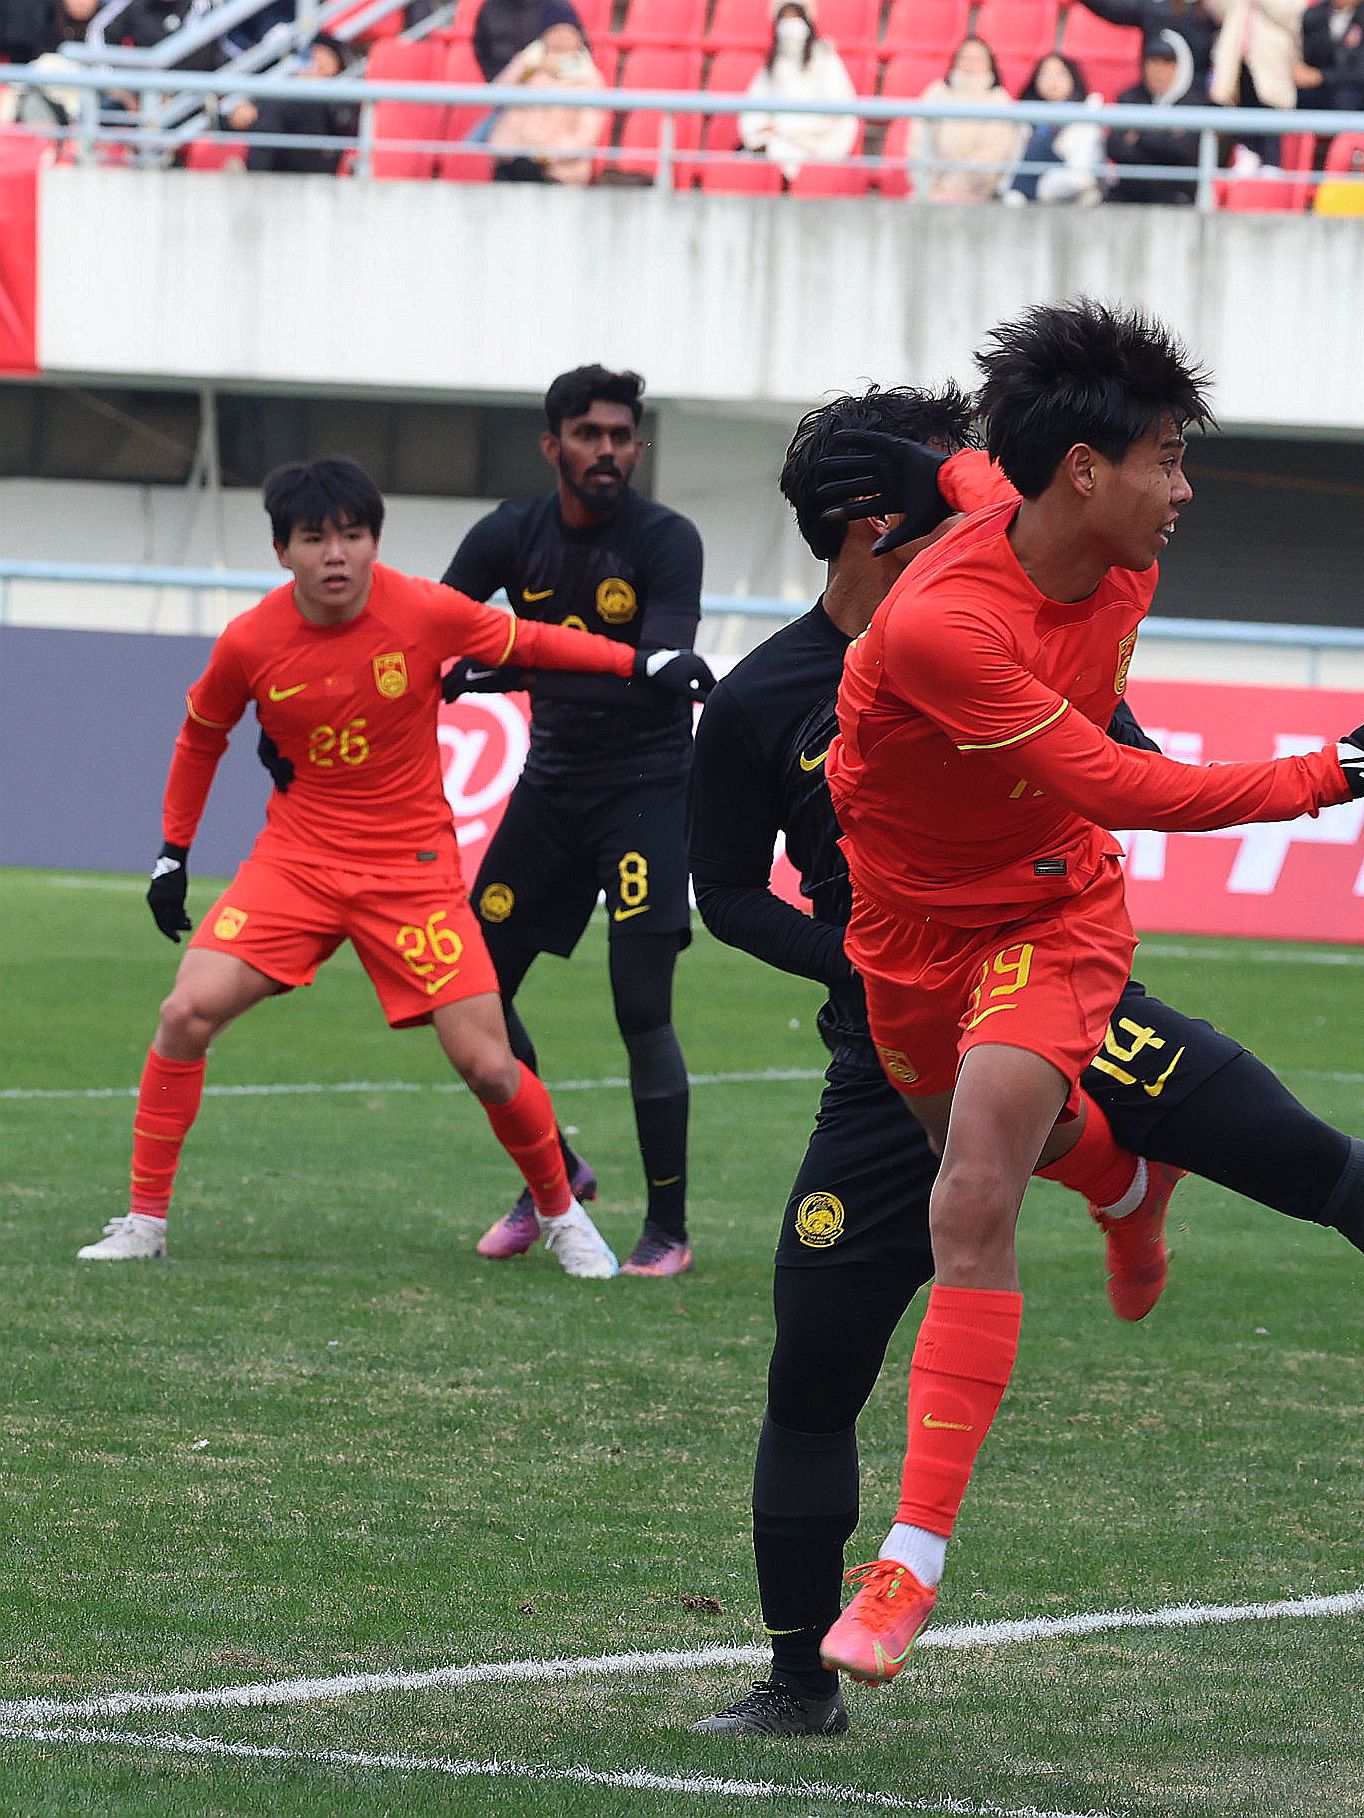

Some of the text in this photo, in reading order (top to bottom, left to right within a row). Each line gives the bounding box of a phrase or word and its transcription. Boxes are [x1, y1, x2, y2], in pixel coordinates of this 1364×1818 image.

[309, 718, 370, 767] 26
[618, 851, 649, 907] 8
[396, 910, 463, 975] 26
[1089, 1017, 1167, 1086] 14
